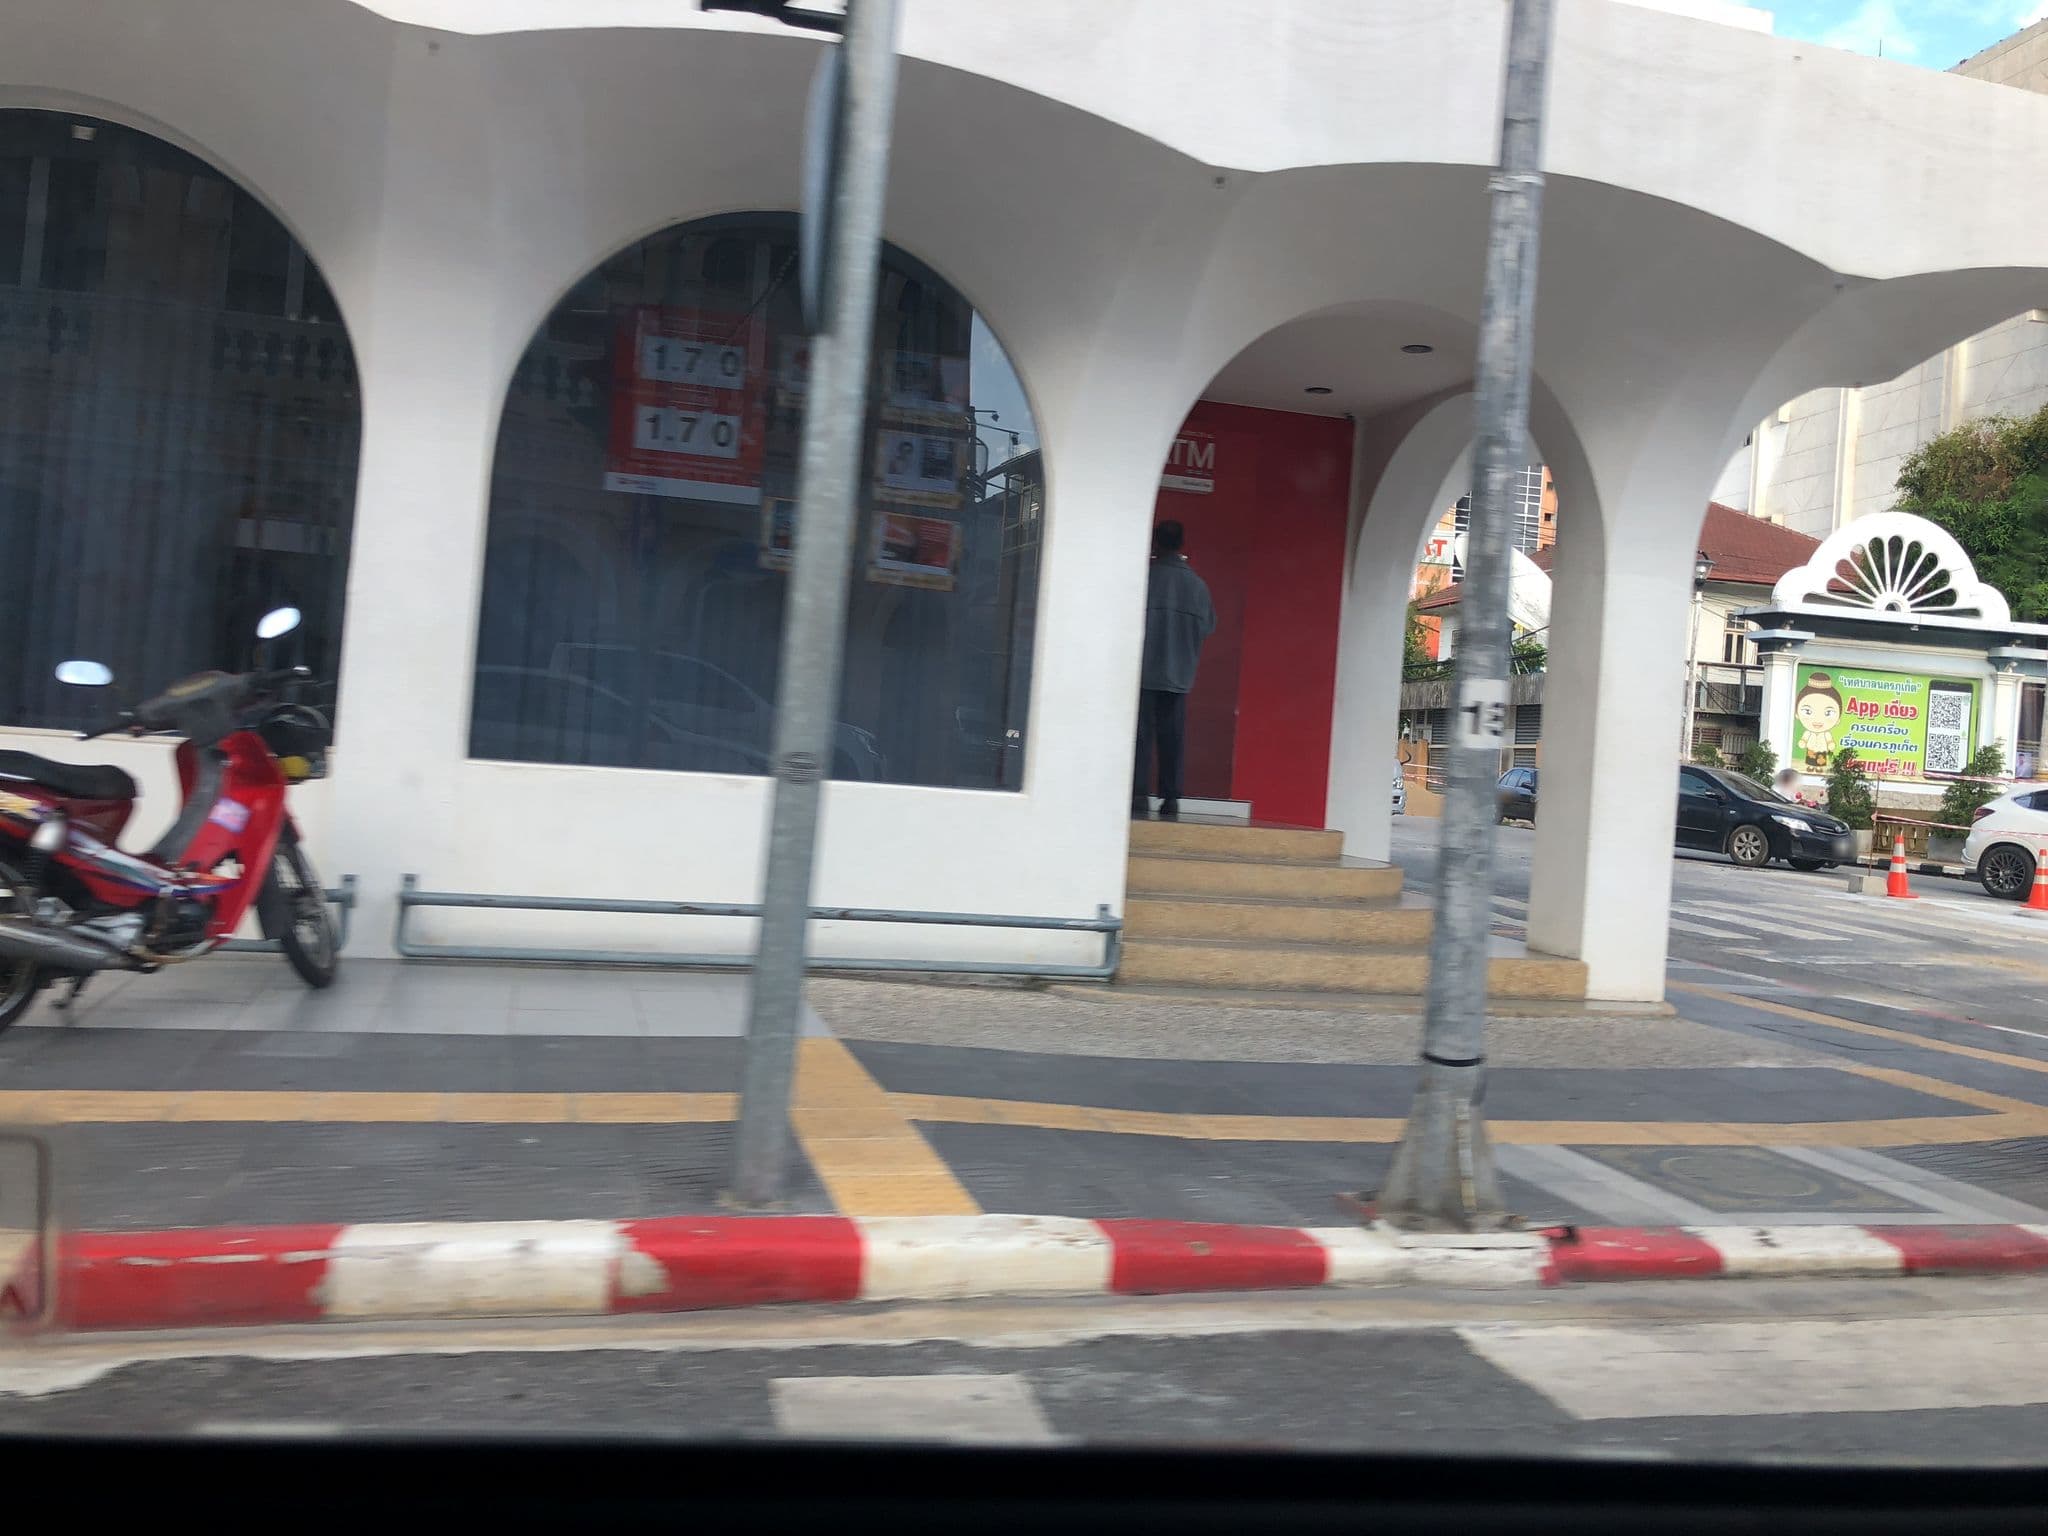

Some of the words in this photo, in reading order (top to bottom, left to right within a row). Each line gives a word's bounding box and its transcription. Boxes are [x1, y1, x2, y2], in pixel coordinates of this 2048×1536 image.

[654, 344, 741, 377] 1.70
[645, 413, 733, 448] 1.70
[1168, 439, 1215, 469] TM
[1846, 697, 1879, 718] App
